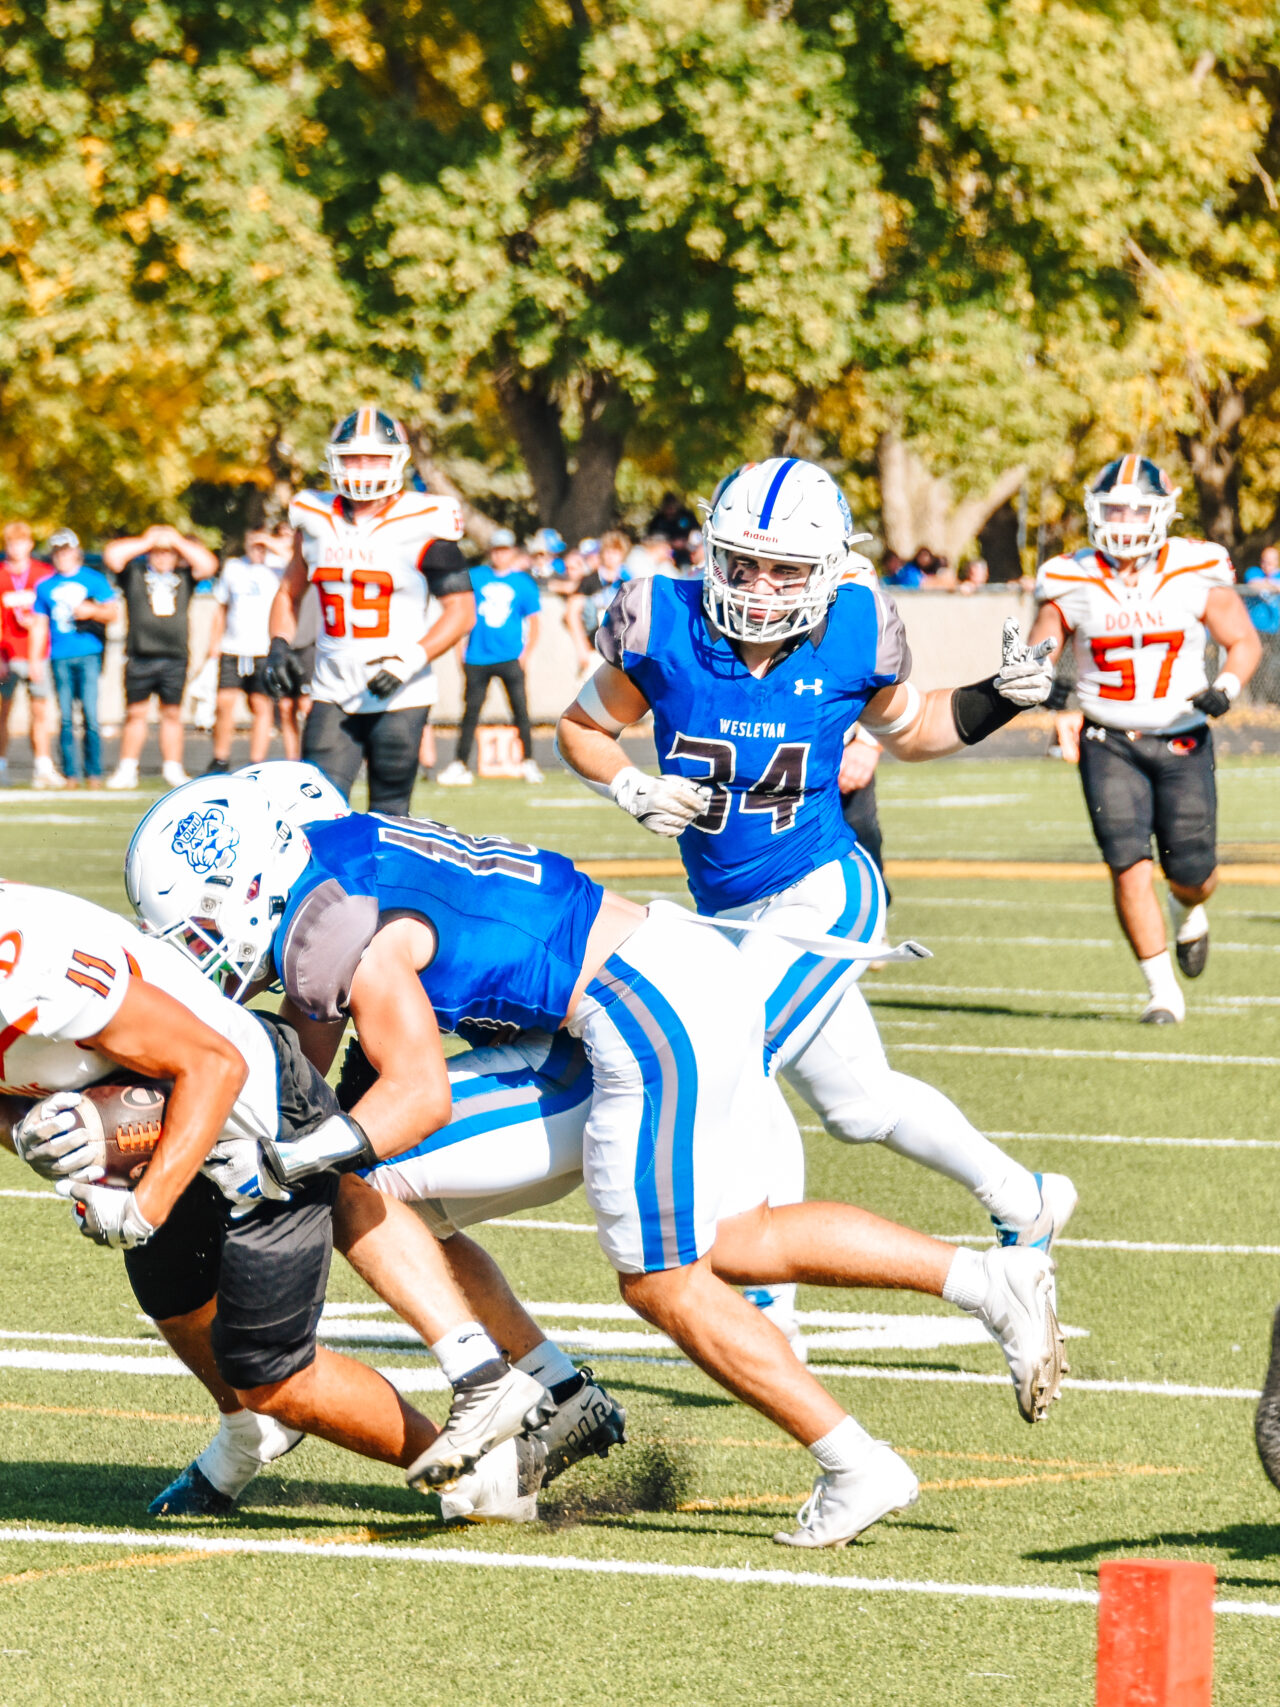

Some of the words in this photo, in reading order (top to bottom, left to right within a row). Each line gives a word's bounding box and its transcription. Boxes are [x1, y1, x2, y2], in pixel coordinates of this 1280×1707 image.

[312, 567, 394, 639] 69
[1104, 610, 1165, 631] DOANE
[1091, 630, 1185, 701] 57
[720, 718, 786, 738] WESLEYAN
[665, 731, 811, 835] 34
[65, 949, 116, 999] 11
